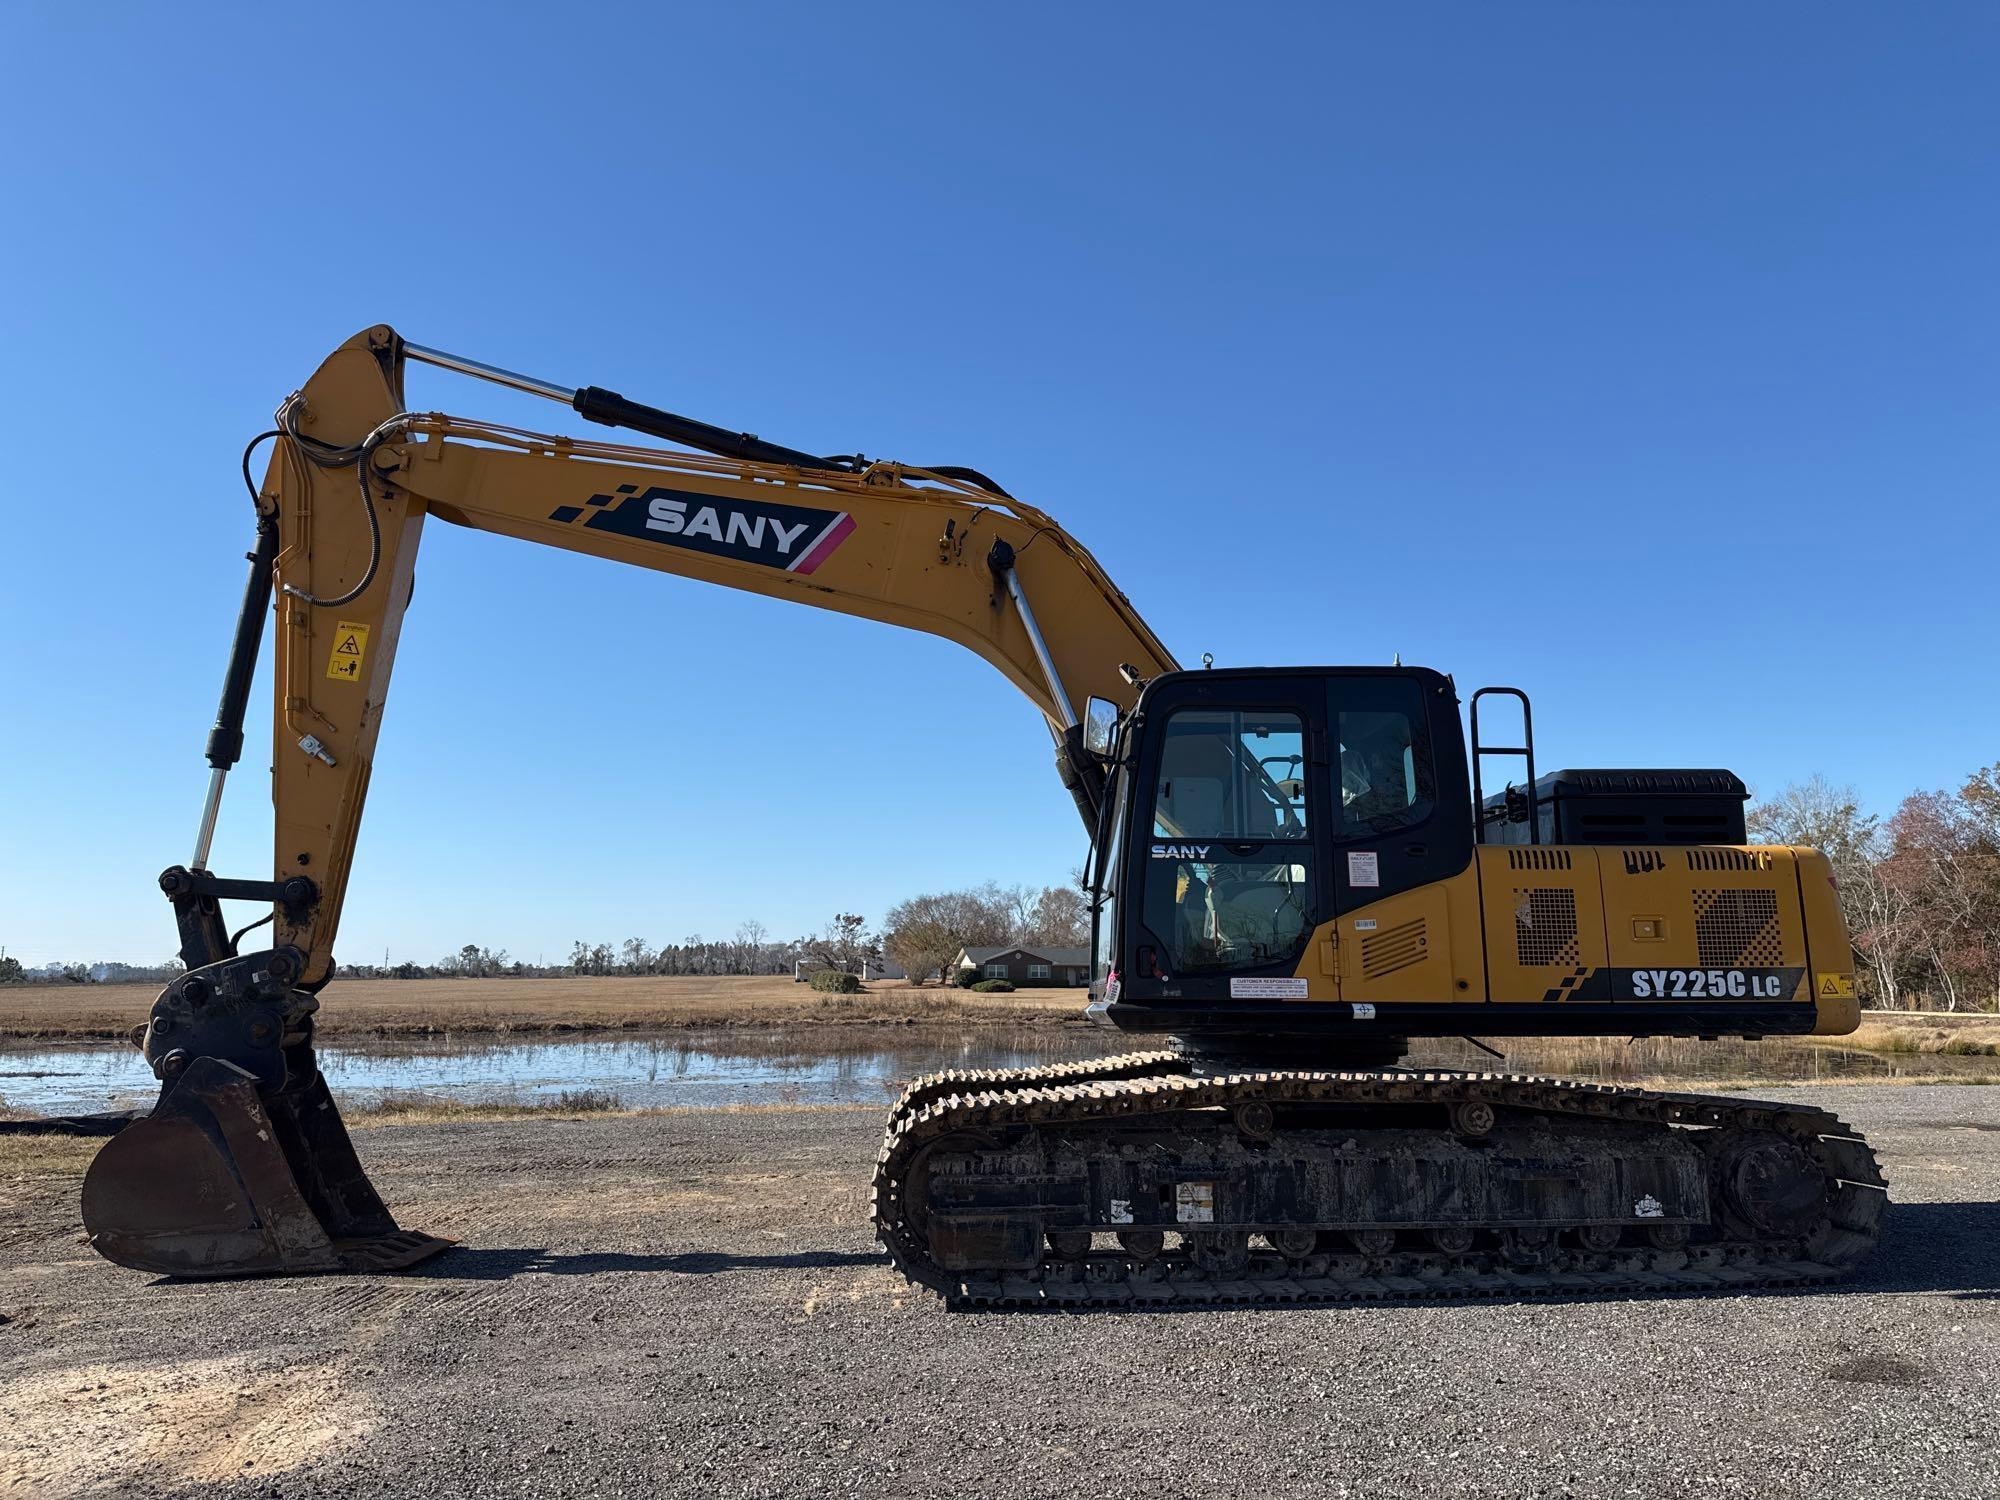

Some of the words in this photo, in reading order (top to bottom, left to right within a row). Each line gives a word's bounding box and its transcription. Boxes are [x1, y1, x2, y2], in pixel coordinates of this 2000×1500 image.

[645, 498, 809, 553] SANY
[1151, 844, 1211, 859] SANY
[1631, 970, 1746, 997] SY225C
[1752, 975, 1781, 997] LC
